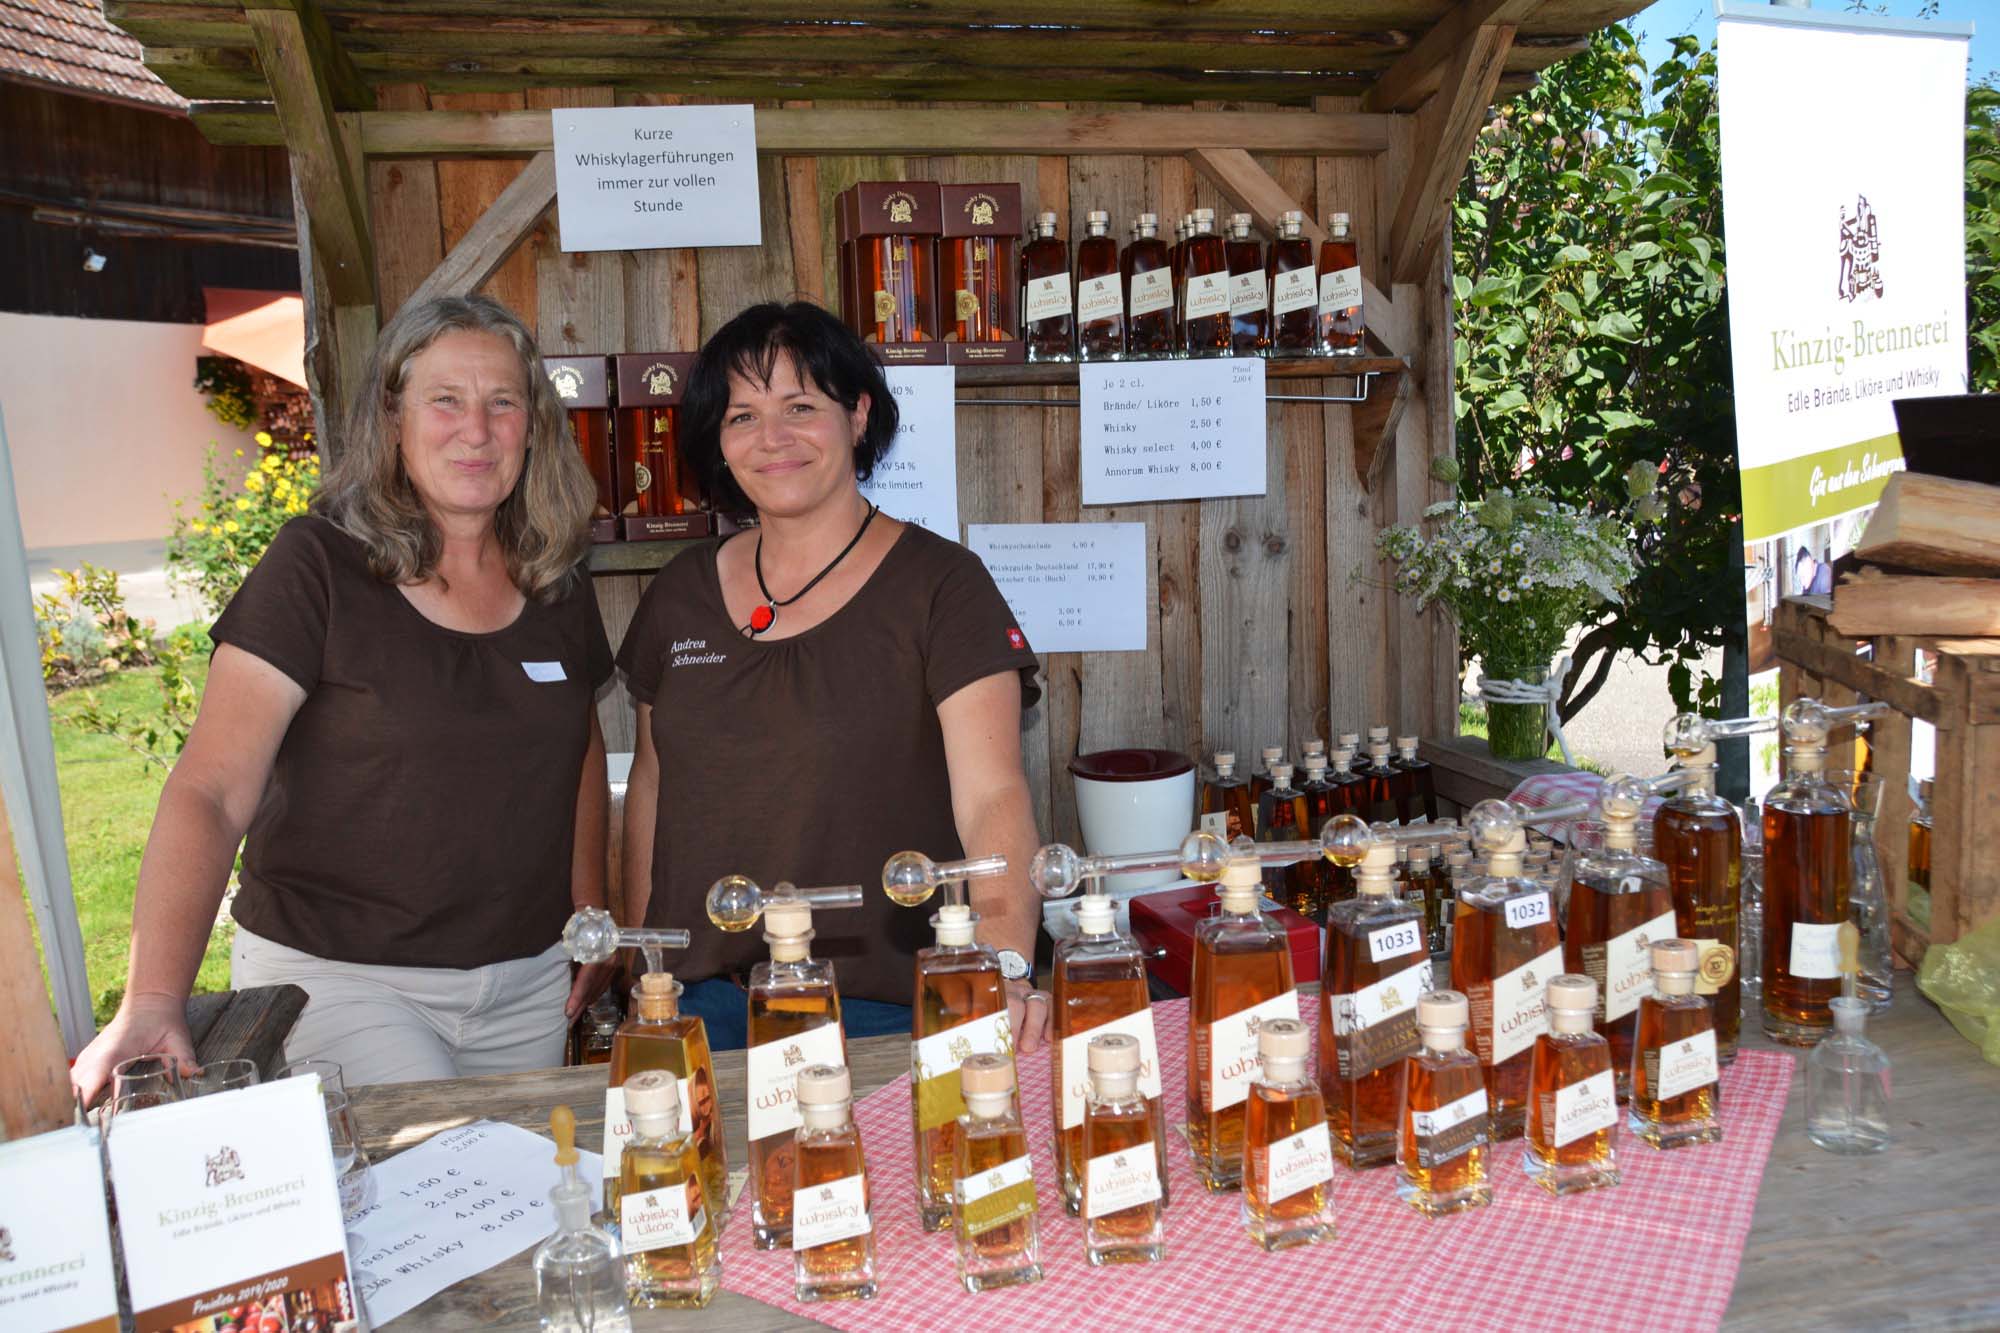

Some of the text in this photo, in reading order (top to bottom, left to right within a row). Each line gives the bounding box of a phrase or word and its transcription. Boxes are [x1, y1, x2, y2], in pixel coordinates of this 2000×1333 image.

[633, 128, 673, 141] Kurze
[575, 151, 734, 168] Whiskylagerführungen
[597, 173, 715, 191] immer zur vollen
[633, 199, 683, 213] Stunde
[1771, 309, 1949, 376] Kinzig-Brennerei
[905, 386, 914, 396] %
[1103, 380, 1114, 390] Je
[1119, 379, 1126, 389] 2
[1788, 365, 1940, 413] Edle Brände, Liköre und Whisky
[1147, 399, 1180, 410] Liköre
[1191, 397, 1213, 408] 1,50
[1216, 396, 1223, 406] €
[909, 424, 916, 433] €
[1103, 418, 1222, 434] Whisky 2,50 €
[1104, 440, 1222, 456] Whisky select 4,00 €
[894, 462, 906, 471] 54
[908, 461, 916, 471] %
[1104, 462, 1222, 477] Annorum Whisky 8,00 €
[888, 479, 924, 490] limitiert
[1810, 465, 1827, 507] Gin
[670, 638, 706, 654] Andrea
[671, 652, 727, 668] Schneider
[1511, 901, 1545, 921] 1032
[1376, 929, 1415, 953] 1033
[1560, 1094, 1611, 1124] whisky
[453, 1137, 479, 1153] 2,00
[1274, 1149, 1329, 1180] whisky
[399, 1168, 461, 1198] 1,50 €
[157, 1173, 306, 1228] Kinzig-Brennerei
[424, 1178, 488, 1209] 2,50 €
[454, 1189, 516, 1221] 4,00 €
[480, 1199, 544, 1233] 8,00 €
[628, 1207, 680, 1225] whisky
[799, 1201, 860, 1228] whisky
[360, 1231, 427, 1268] select
[395, 1239, 465, 1276] Whisky
[237, 1276, 289, 1301] 2019/2020
